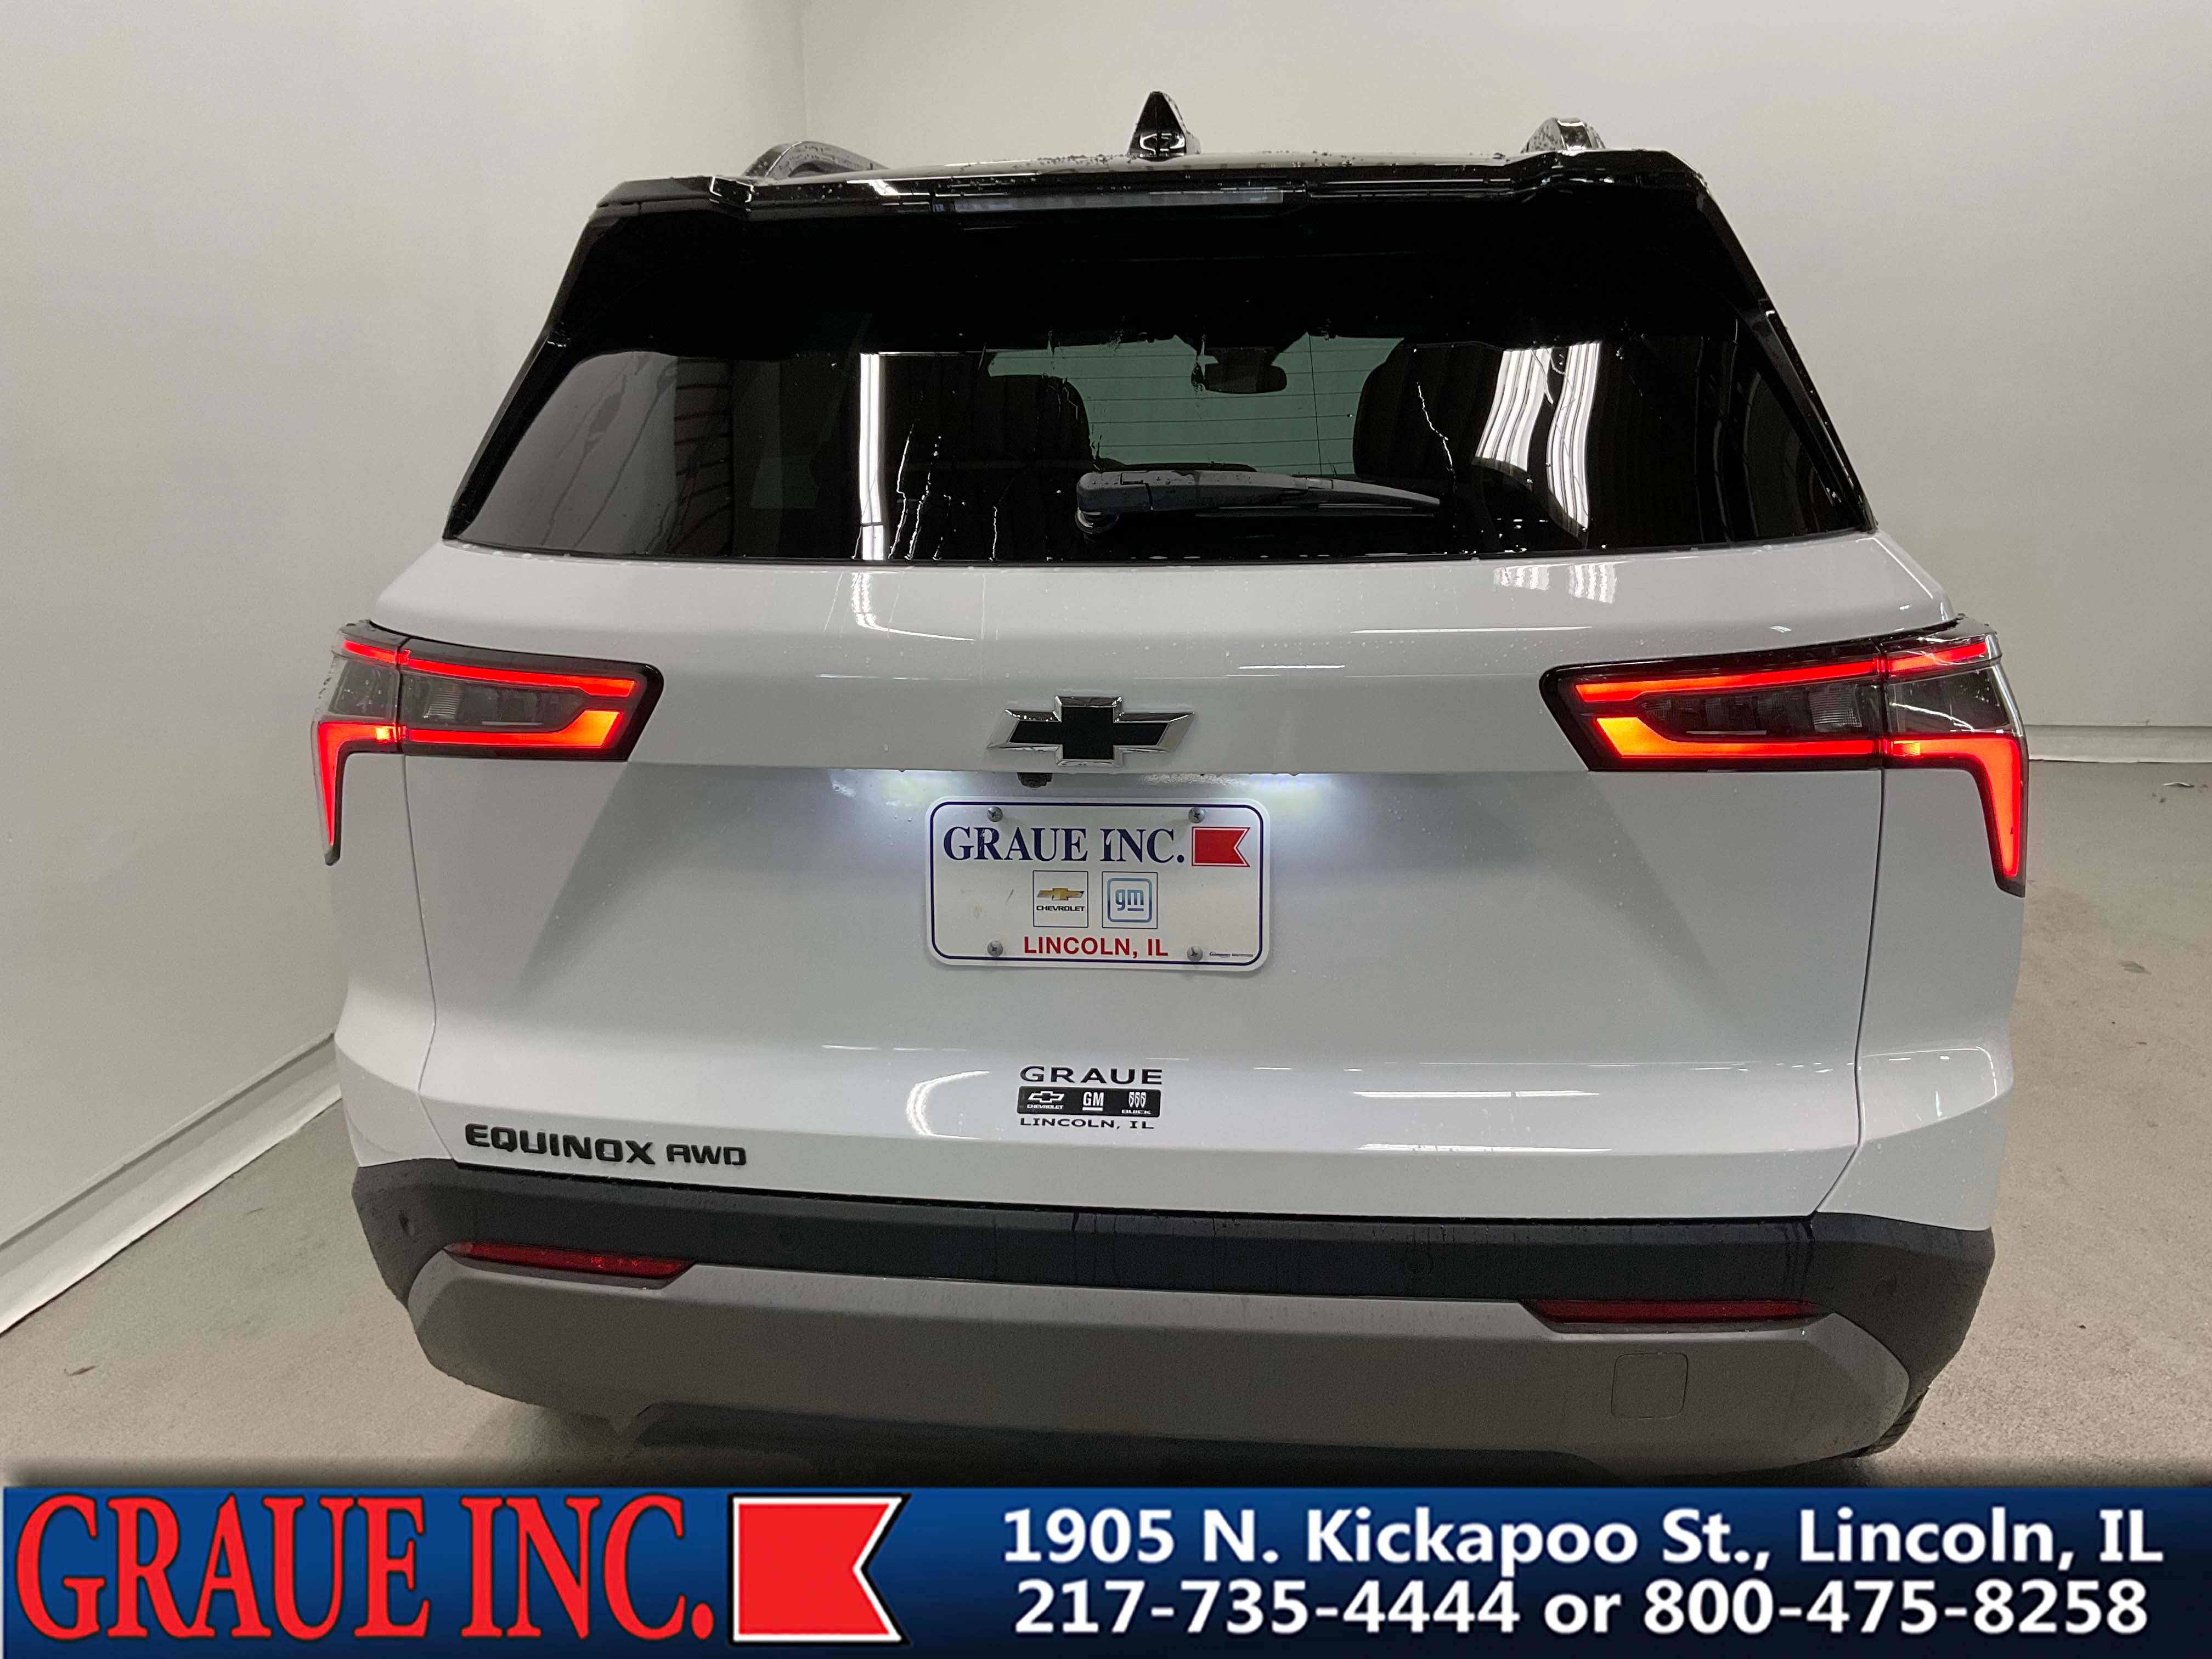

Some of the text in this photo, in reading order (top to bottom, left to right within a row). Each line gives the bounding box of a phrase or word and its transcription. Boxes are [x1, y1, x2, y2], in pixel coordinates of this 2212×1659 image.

[943, 826, 1184, 864] GRAUE INC.
[1115, 889, 1144, 912] gm
[1024, 936, 1169, 957] LINCOLN, IL
[1020, 1065, 1163, 1085] GRAUE
[1082, 1091, 1104, 1107] GM
[1020, 1117, 1154, 1129] LINCOLN, IL
[465, 1123, 747, 1166] EQUINOX AWD
